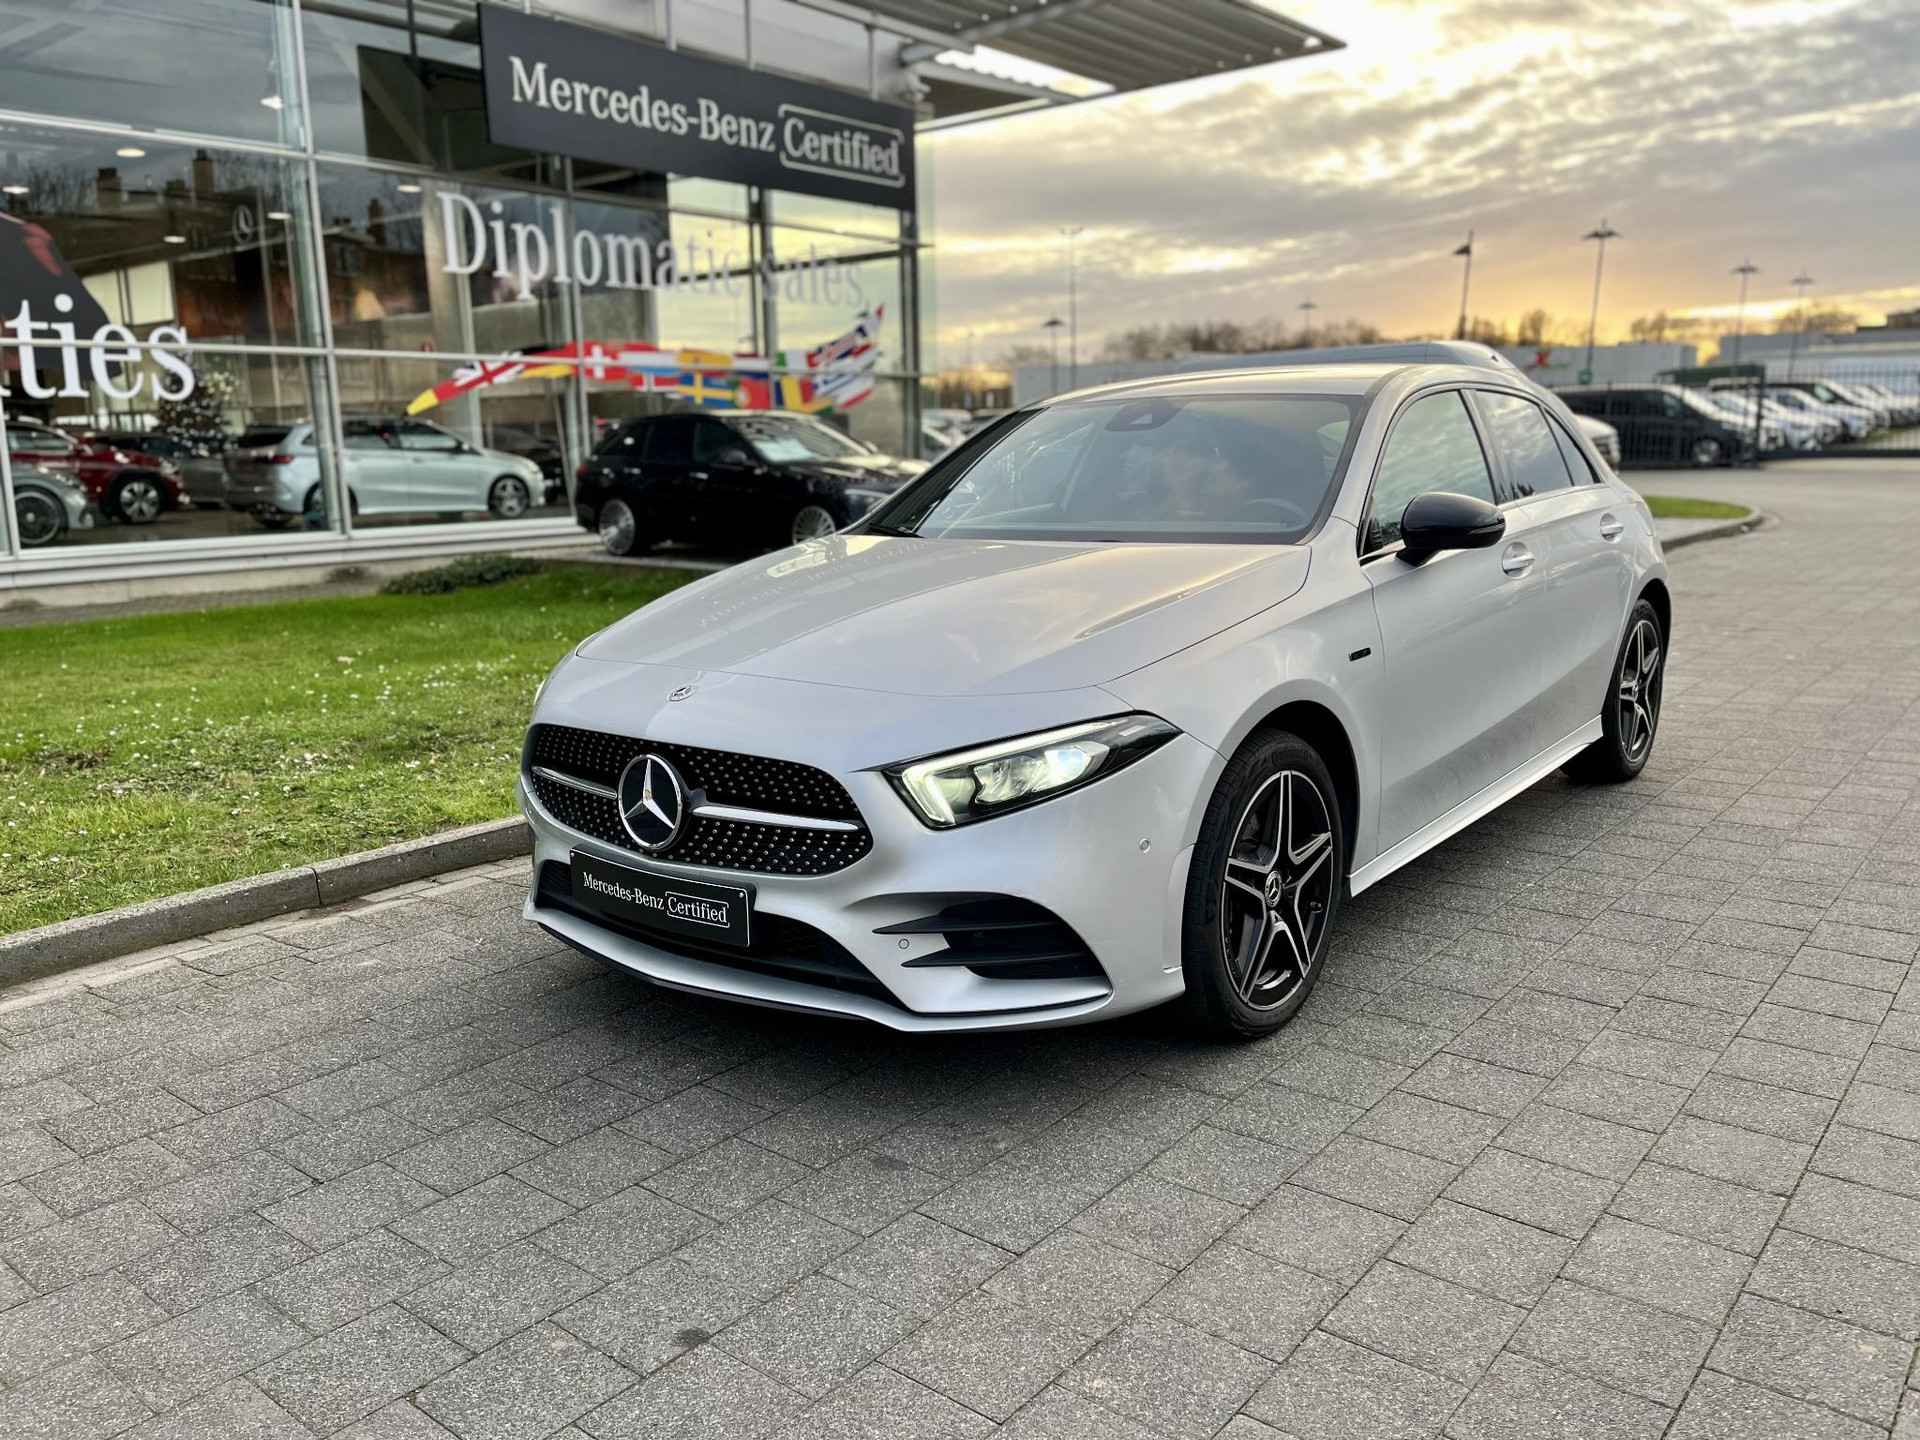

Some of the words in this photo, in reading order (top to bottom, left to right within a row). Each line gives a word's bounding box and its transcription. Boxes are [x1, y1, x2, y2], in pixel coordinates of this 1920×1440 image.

[508, 56, 776, 153] Mercedes-Benz
[783, 117, 901, 176] Certified
[436, 191, 743, 301] Diplomatic
[0, 293, 195, 401] ties
[582, 871, 665, 911] Mercedes-Benz
[667, 896, 728, 924] Certified
